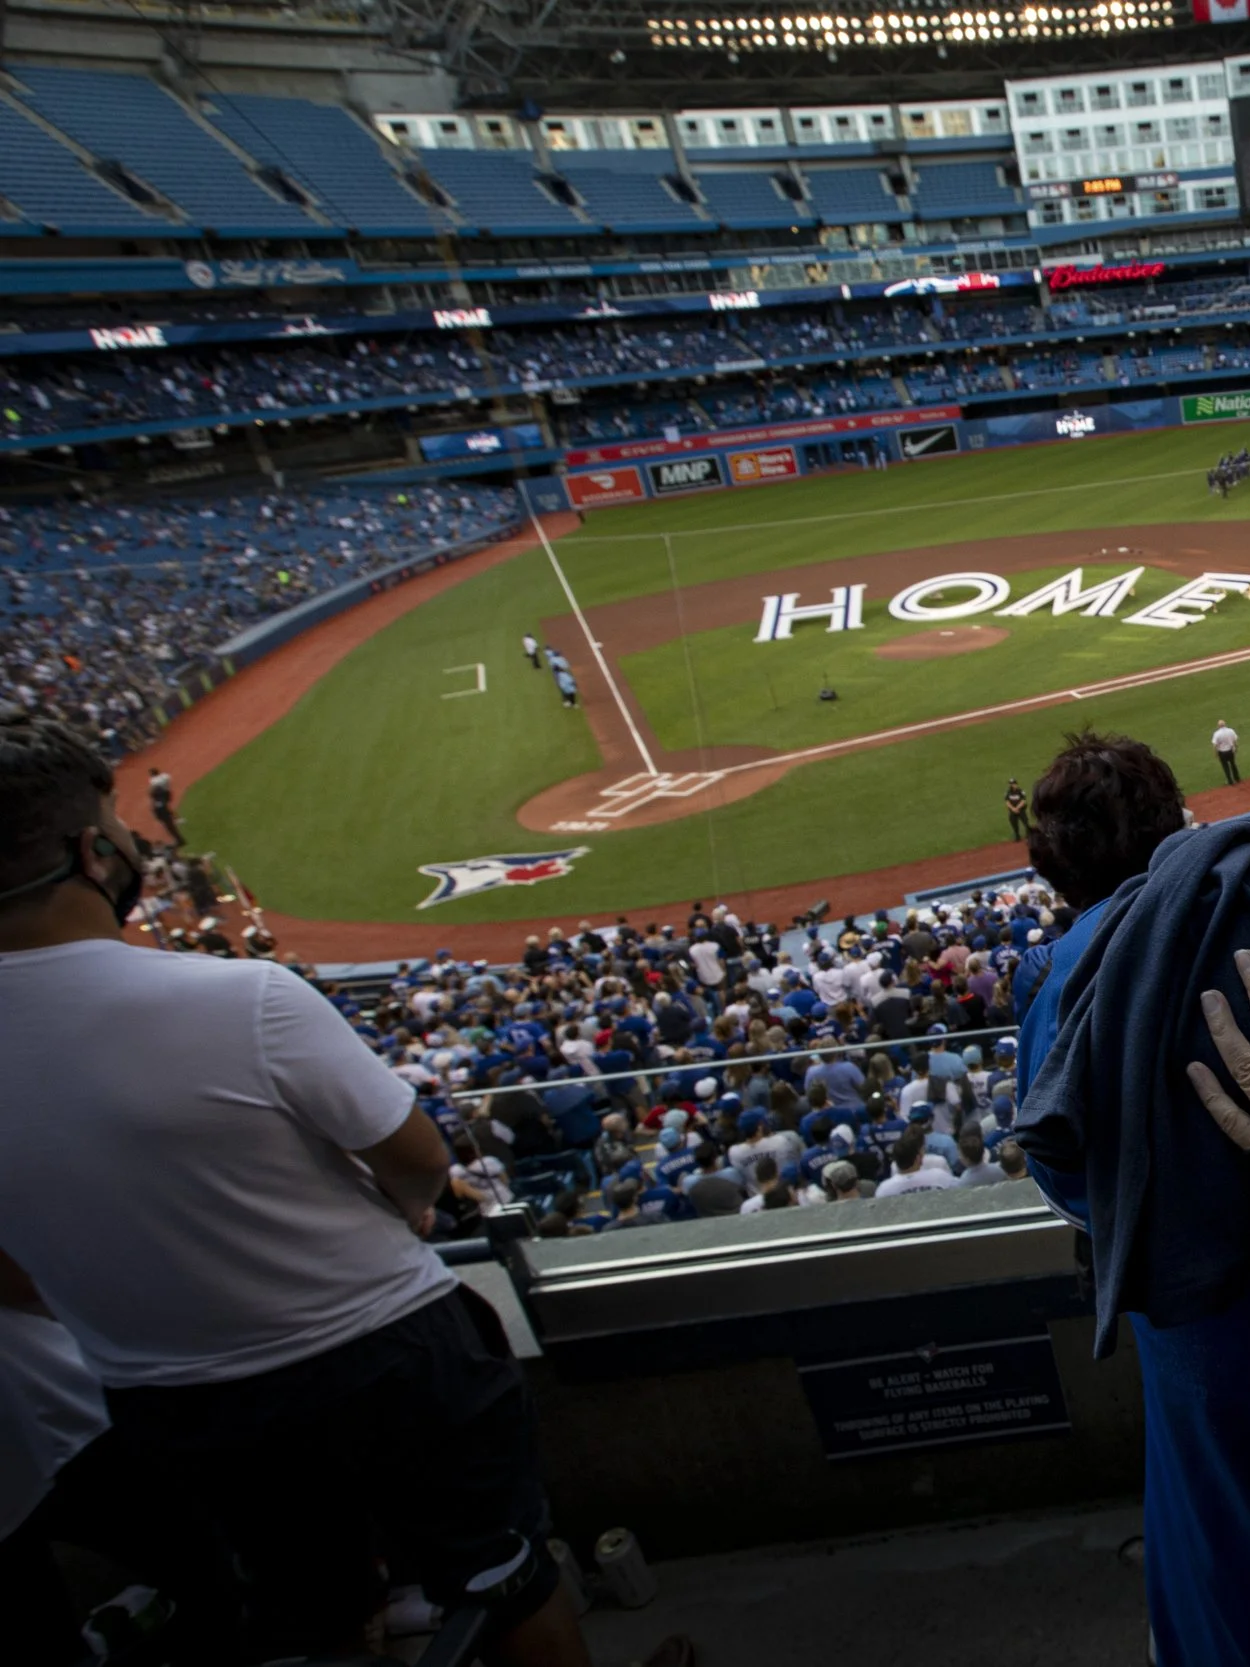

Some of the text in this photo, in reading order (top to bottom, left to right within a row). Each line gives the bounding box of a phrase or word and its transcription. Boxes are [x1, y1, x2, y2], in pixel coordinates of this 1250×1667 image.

[1043, 259, 1165, 289] Budweiser
[89, 326, 168, 350] HOME
[1056, 417, 1095, 434] HOME
[661, 460, 712, 485] MNP
[868, 1376, 884, 1390] BE
[887, 1372, 920, 1387] ALERT
[932, 1365, 969, 1380] WATCH
[972, 1362, 995, 1376] FOR
[884, 1376, 988, 1399] FLYING BASEBALLS
[833, 1393, 1050, 1433] THROWING OF ANY ITEMS ON THE PLAYING
[858, 1408, 1032, 1442] SURFACE IS STRICTLY PROHIBITED
